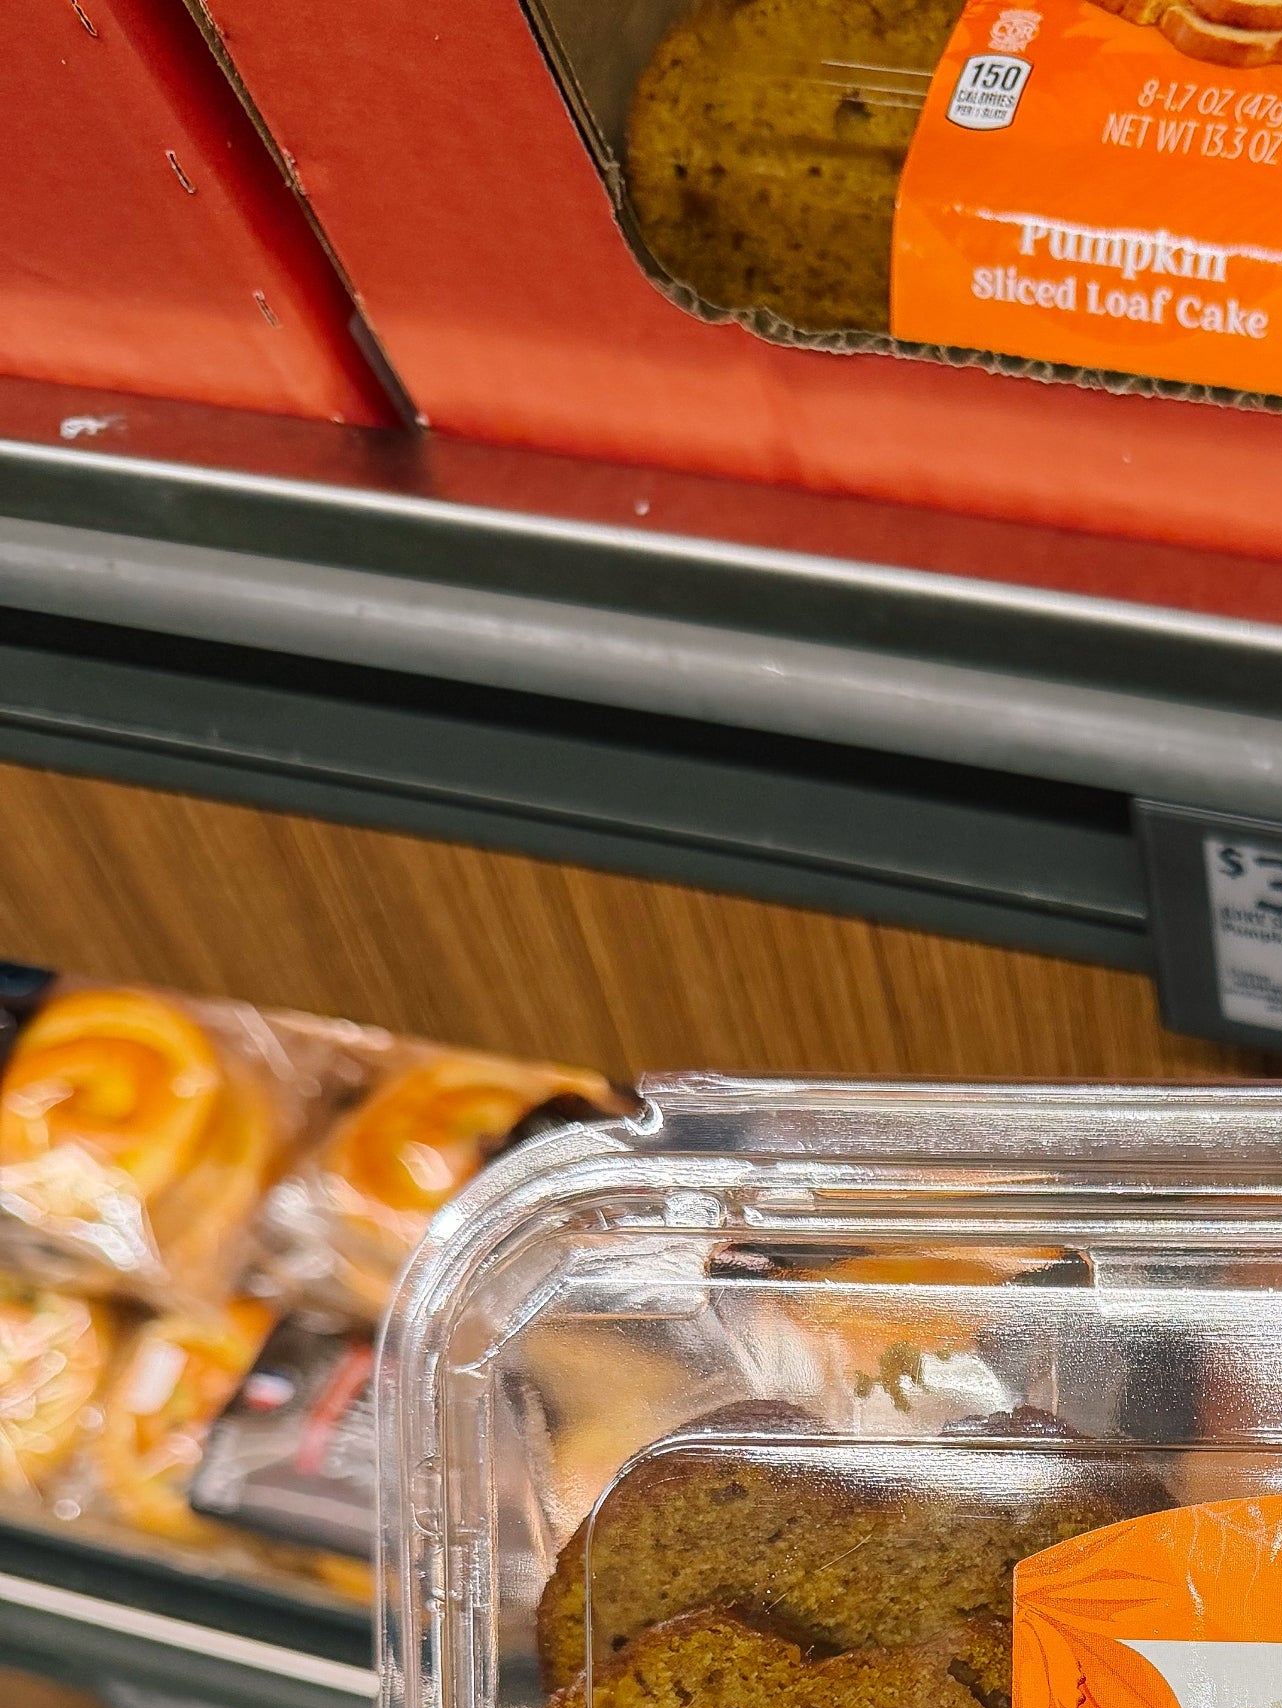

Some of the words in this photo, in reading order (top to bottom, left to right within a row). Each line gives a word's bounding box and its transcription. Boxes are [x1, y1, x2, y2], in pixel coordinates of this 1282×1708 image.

[971, 63, 1022, 91] 150
[1138, 79, 1198, 113] 8-1.7
[1197, 87, 1236, 117] OZ
[1102, 112, 1153, 149] NET
[1156, 119, 1200, 154] WT
[1201, 123, 1248, 160] 13.3
[1018, 219, 1228, 283] Pumpkin
[970, 264, 1077, 312] Sliced
[1086, 280, 1173, 325] Loaf
[1175, 293, 1270, 340] Cake
